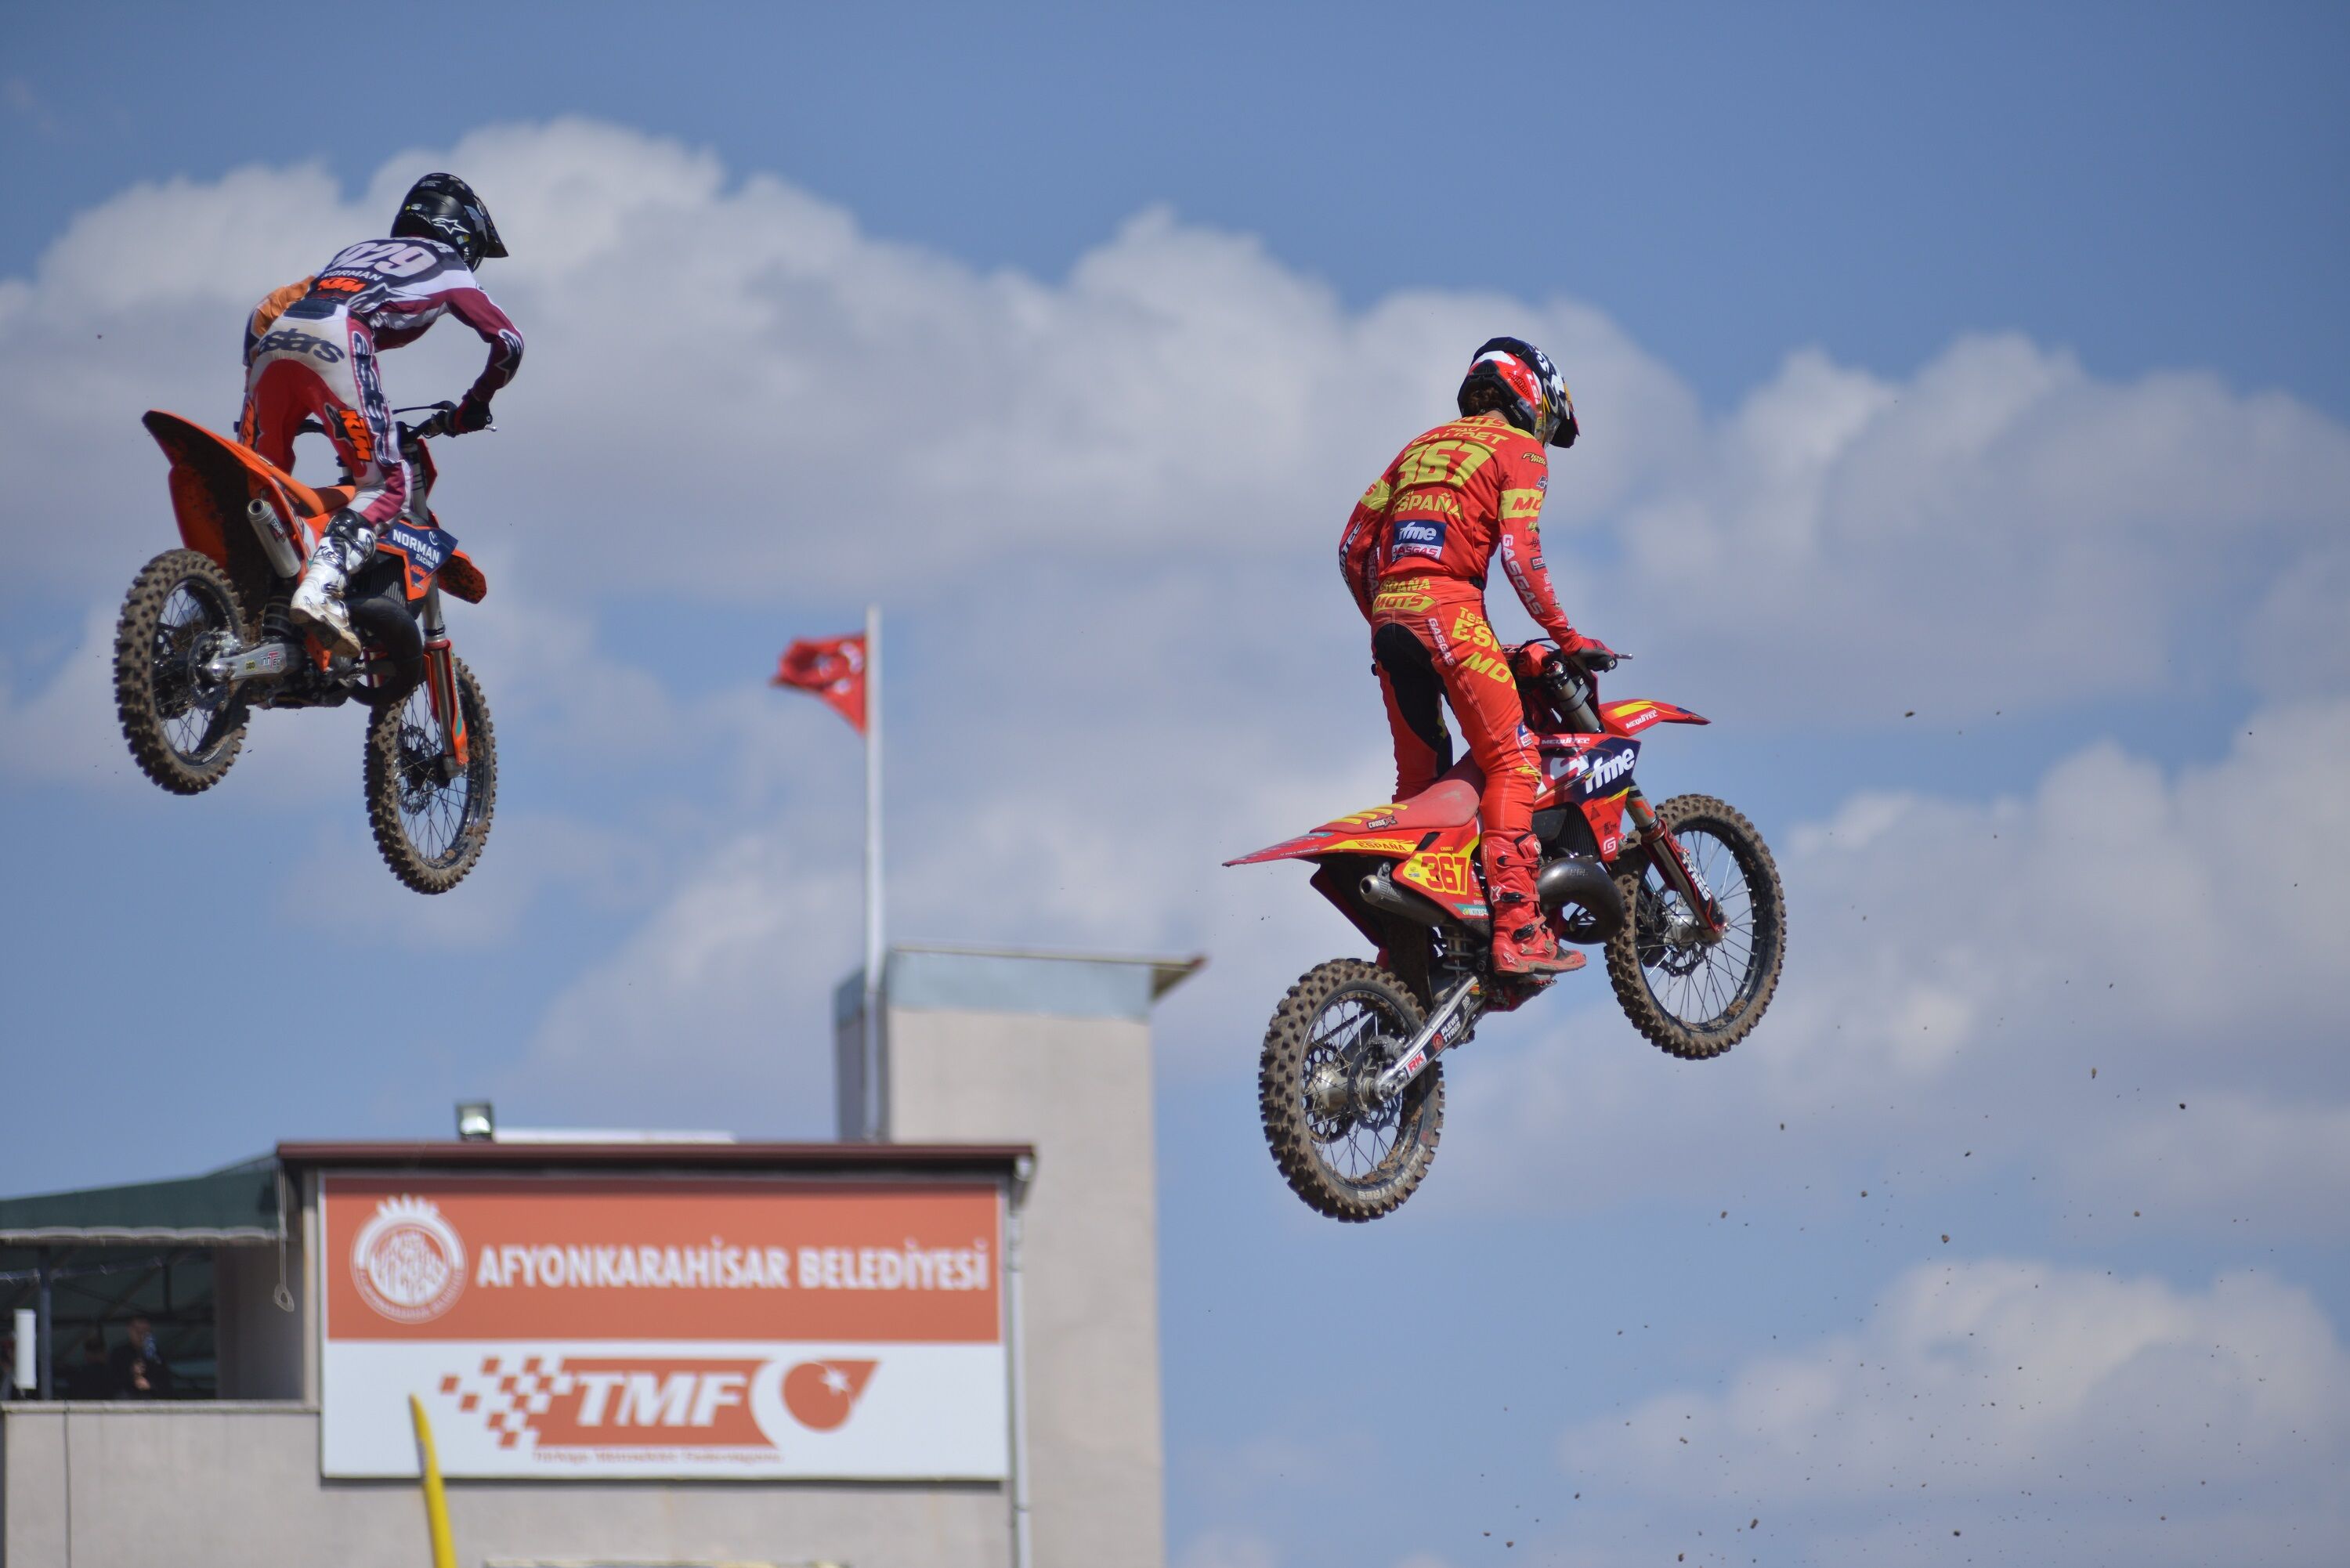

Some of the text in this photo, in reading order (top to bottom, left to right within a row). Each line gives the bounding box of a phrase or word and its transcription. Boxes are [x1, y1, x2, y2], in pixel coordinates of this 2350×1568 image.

[317, 276, 367, 292] KTM
[321, 269, 384, 281] NORMAN
[338, 409, 372, 462] KTM
[392, 529, 440, 564] NORMAN
[415, 554, 434, 569] RACING
[1502, 533, 1545, 616] GASGAS
[1374, 595, 1424, 609] MOTS
[1459, 606, 1488, 627] Tea
[1585, 748, 1635, 794] rfme
[1421, 855, 1467, 891] 367
[1441, 1013, 1459, 1036] PLEWS
[1443, 1021, 1462, 1043] TYRES
[1408, 1053, 1425, 1072] RK
[475, 1234, 992, 1291] AFYONKARAHİSAR BELEDİYESİ
[576, 1372, 747, 1427] TMF
